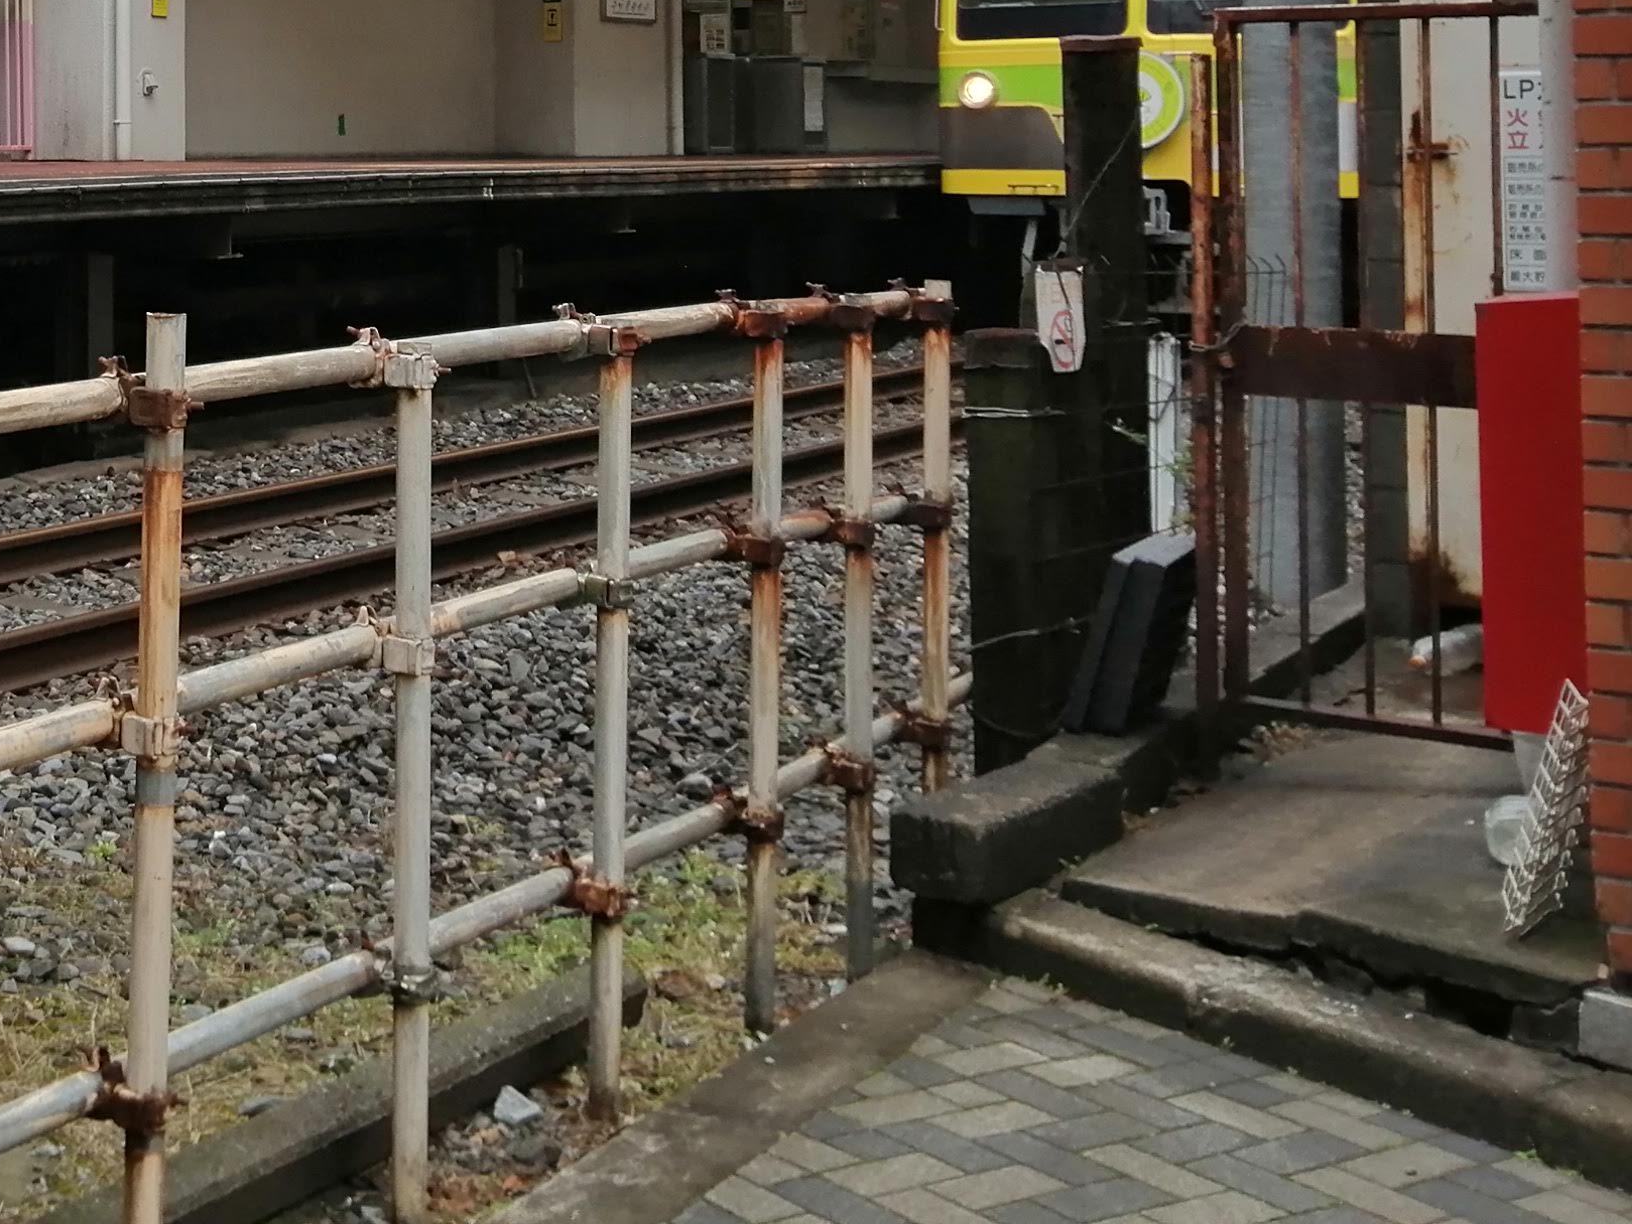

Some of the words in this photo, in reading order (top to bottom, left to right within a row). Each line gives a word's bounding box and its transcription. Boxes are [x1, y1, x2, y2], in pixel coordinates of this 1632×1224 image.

[1504, 79, 1542, 99] LP
[1507, 108, 1542, 127] 火
[1507, 131, 1543, 149] 立
